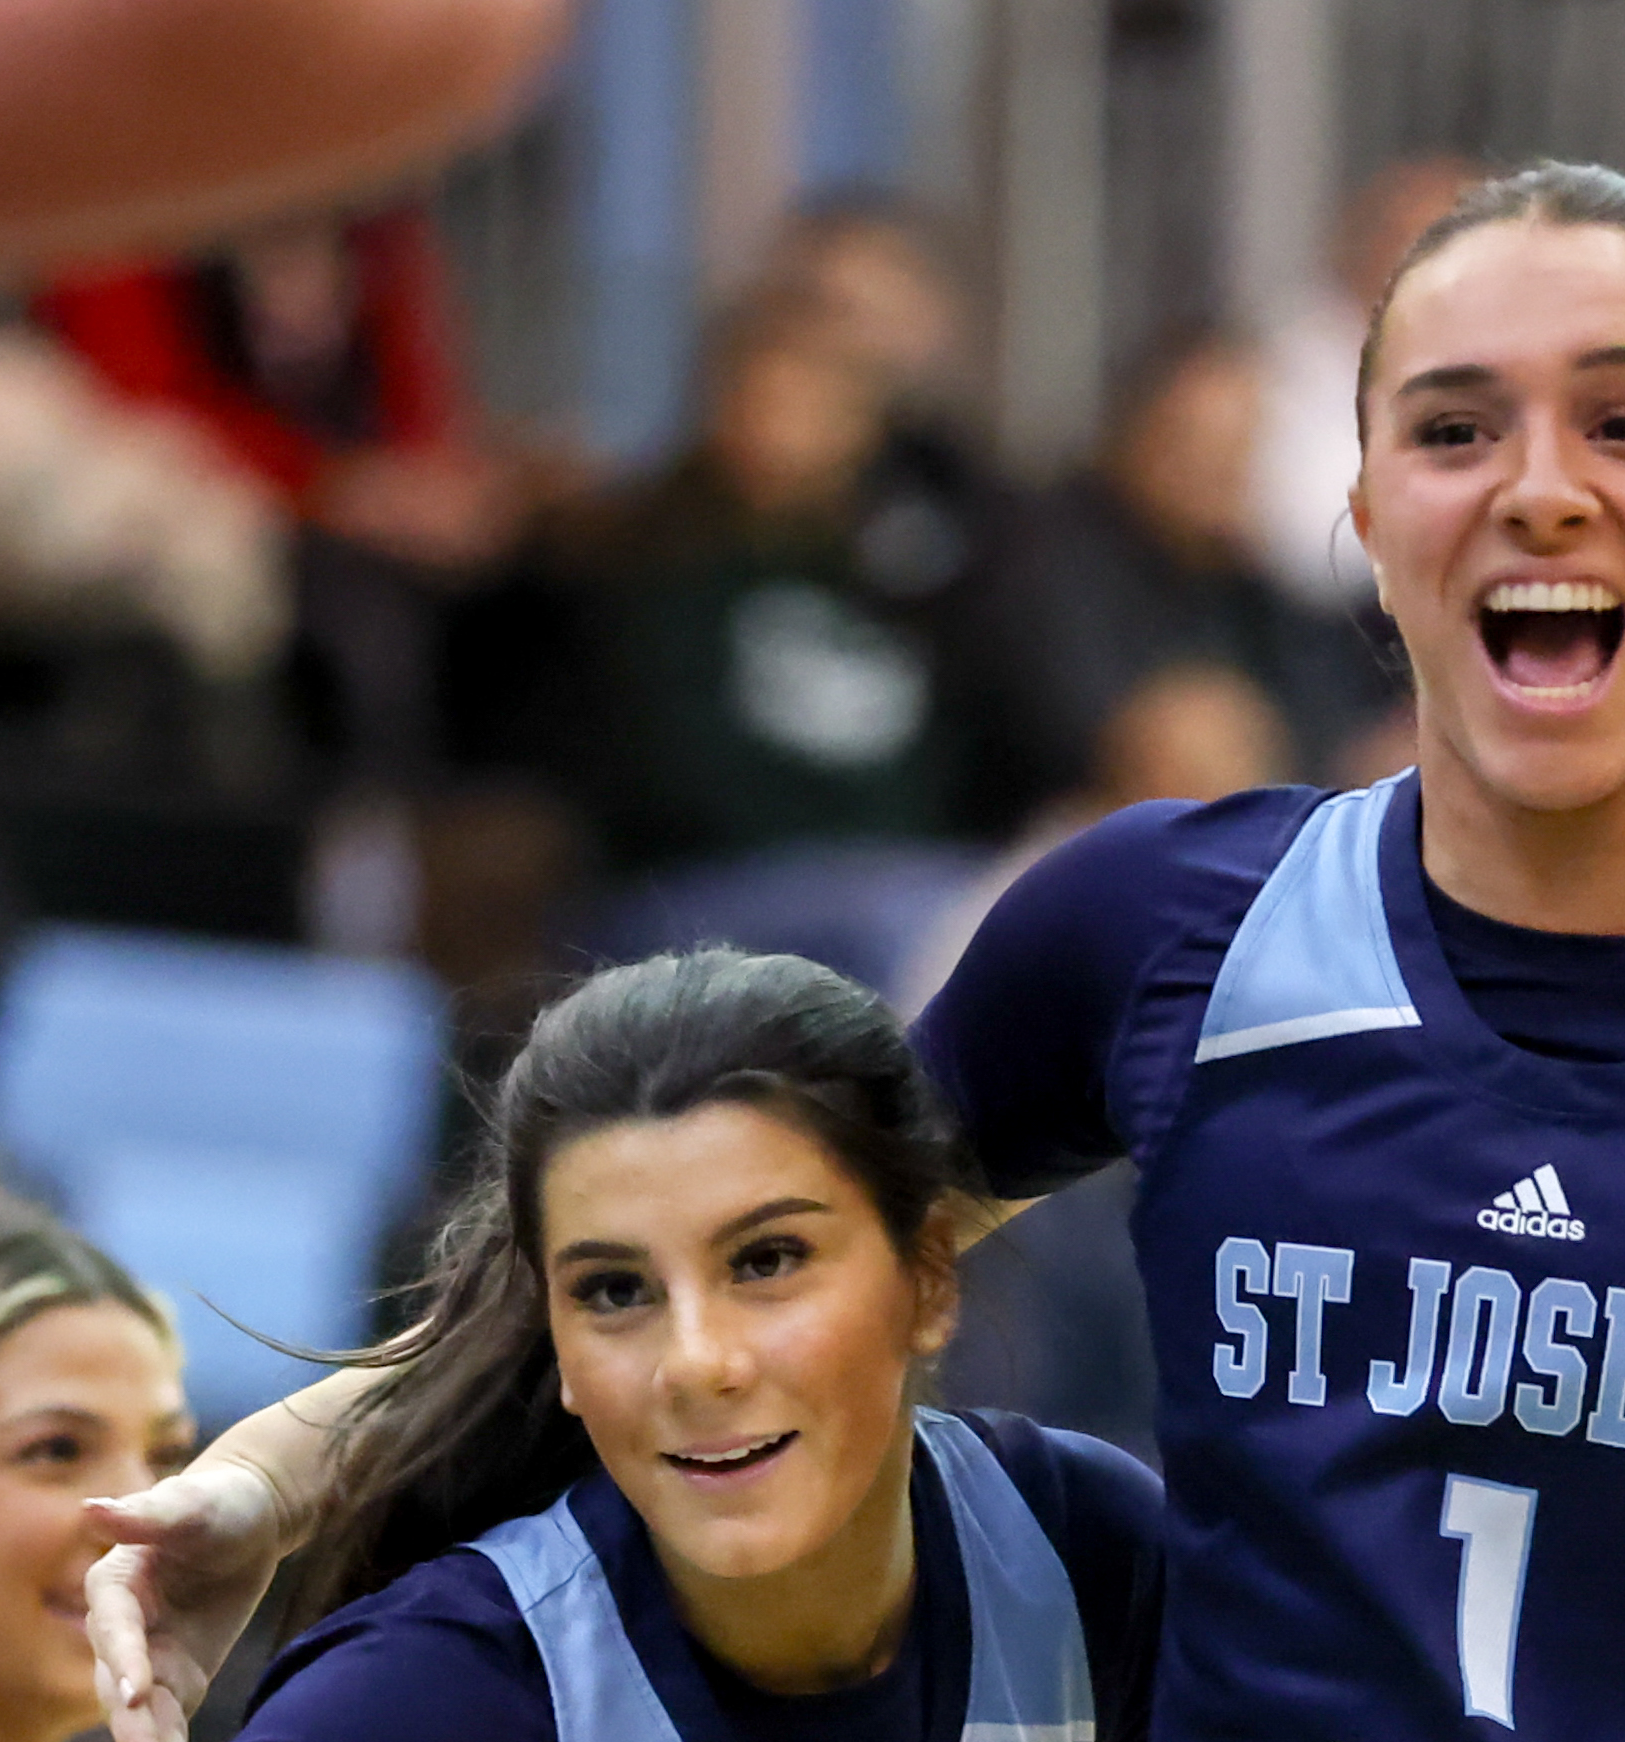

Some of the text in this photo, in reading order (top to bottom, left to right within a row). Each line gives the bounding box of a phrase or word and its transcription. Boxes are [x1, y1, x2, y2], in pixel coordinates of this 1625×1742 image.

[1476, 1206, 1586, 1241] adidas
[1213, 1236, 1355, 1407] ST
[1439, 1472, 1539, 1731] 1
